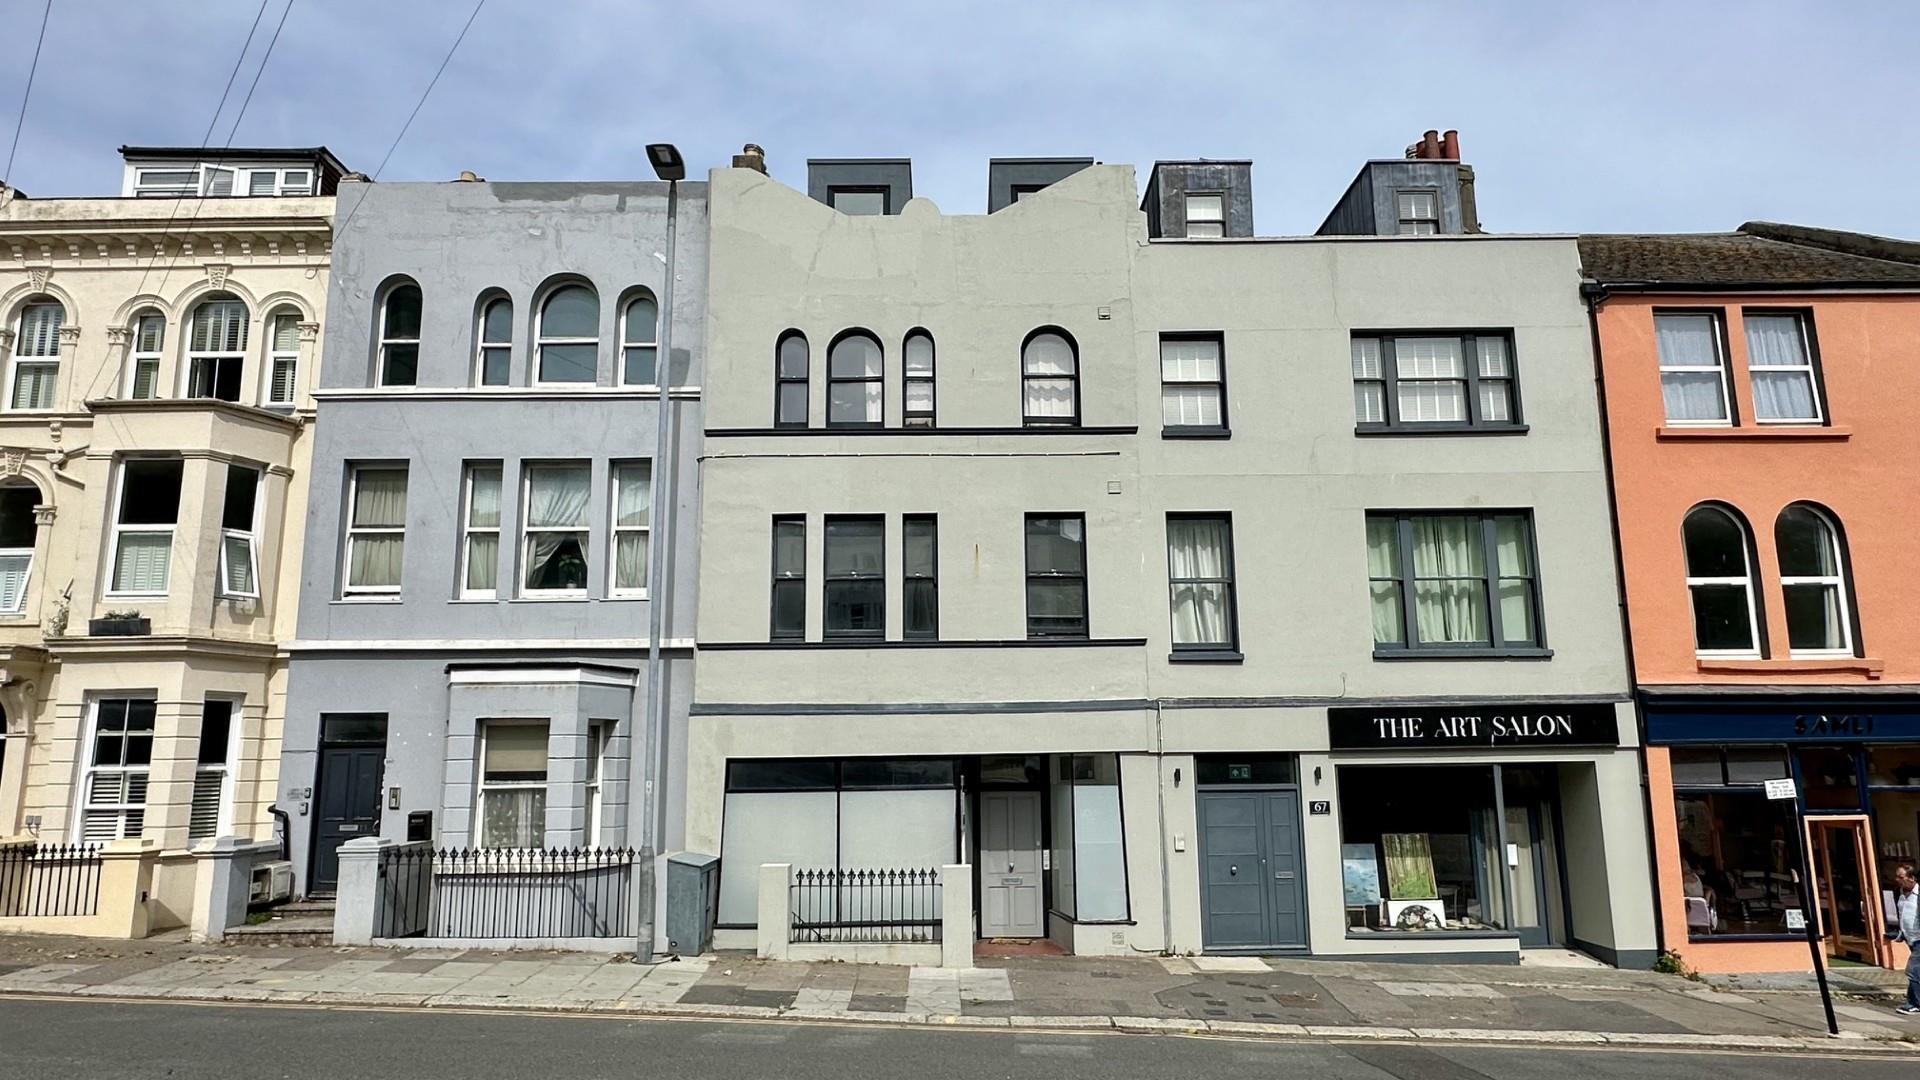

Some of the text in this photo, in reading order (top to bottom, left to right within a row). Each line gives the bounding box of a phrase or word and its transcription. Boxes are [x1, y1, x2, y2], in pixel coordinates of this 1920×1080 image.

[1373, 714, 1573, 738] THE ART SALON
[1314, 801, 1327, 812] 67
